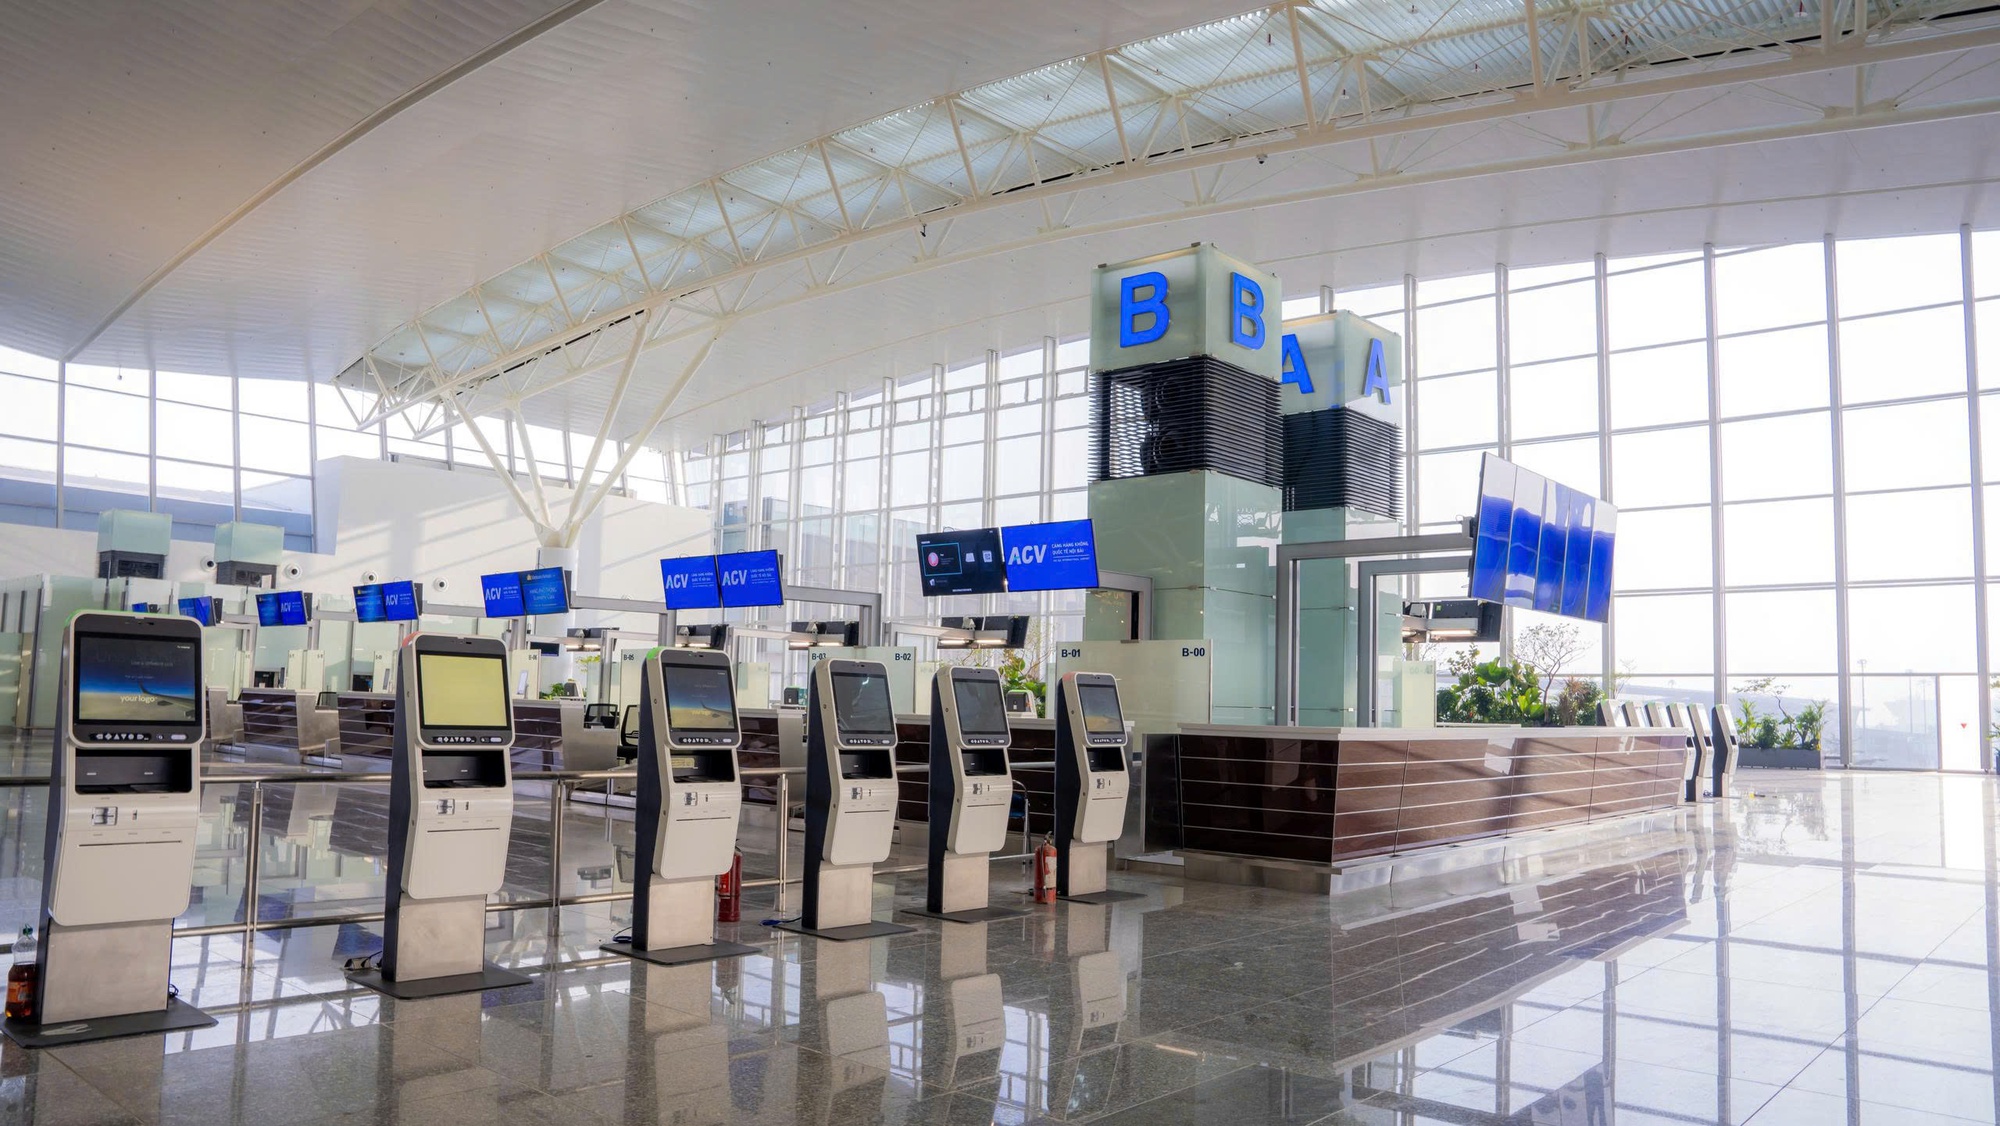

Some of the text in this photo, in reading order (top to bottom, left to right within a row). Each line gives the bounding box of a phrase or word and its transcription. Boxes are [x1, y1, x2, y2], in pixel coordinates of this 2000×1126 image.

[1120, 271, 1170, 348] B
[1230, 271, 1266, 350] B
[1282, 333, 1314, 394] A
[1362, 337, 1392, 405] A
[1008, 544, 1047, 566] ACV
[665, 574, 689, 589] ACV
[722, 569, 748, 586] ACV
[485, 587, 501, 601] ACV
[895, 652, 912, 661] B-02
[1061, 648, 1081, 657] B-01
[1182, 647, 1205, 657] B-00
[120, 695, 137, 703] your
